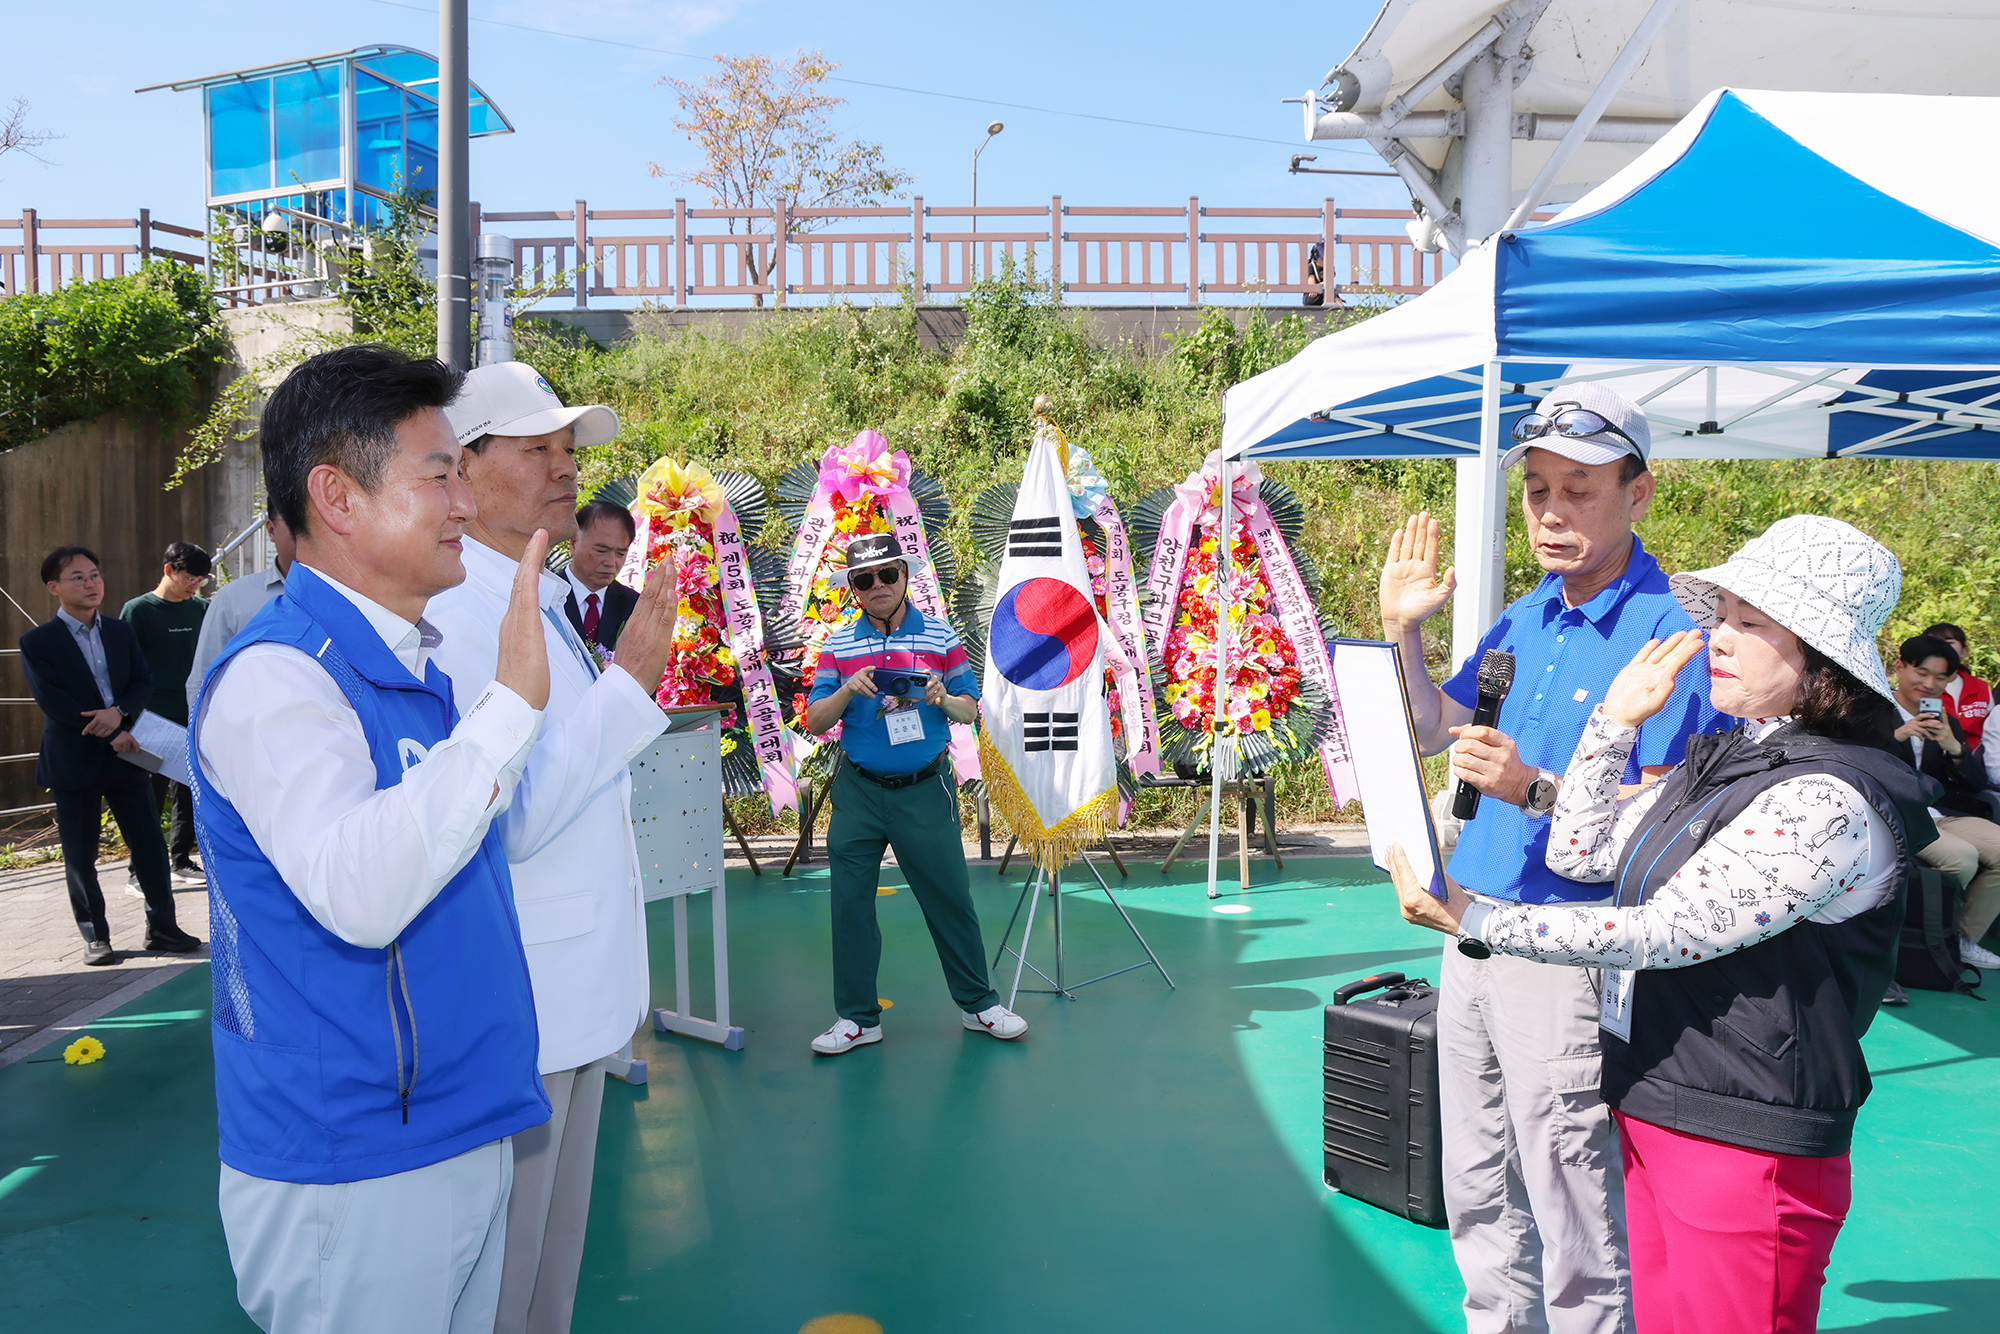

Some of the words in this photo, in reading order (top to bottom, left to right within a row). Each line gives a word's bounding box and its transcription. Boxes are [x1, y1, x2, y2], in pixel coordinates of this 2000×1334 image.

[896, 515, 918, 527] 祝
[718, 532, 740, 545] 祝
[900, 532, 921, 558] 제5
[1108, 522, 1124, 562] 제5회
[1257, 528, 1281, 559] 제5회
[720, 552, 746, 591] 제5회
[732, 599, 763, 672] 도봉구청장배
[748, 679, 783, 764] 파크골프대회
[1815, 791, 1832, 805] LA
[1781, 814, 1807, 825] MACAO
[1730, 888, 1757, 900] LDS
[1763, 869, 1779, 884] LDS
[1783, 883, 1809, 899] SPORT
[1686, 906, 1701, 921] LDS
[1555, 935, 1577, 955] DUBAI
[1596, 938, 1616, 956] SEOUL
